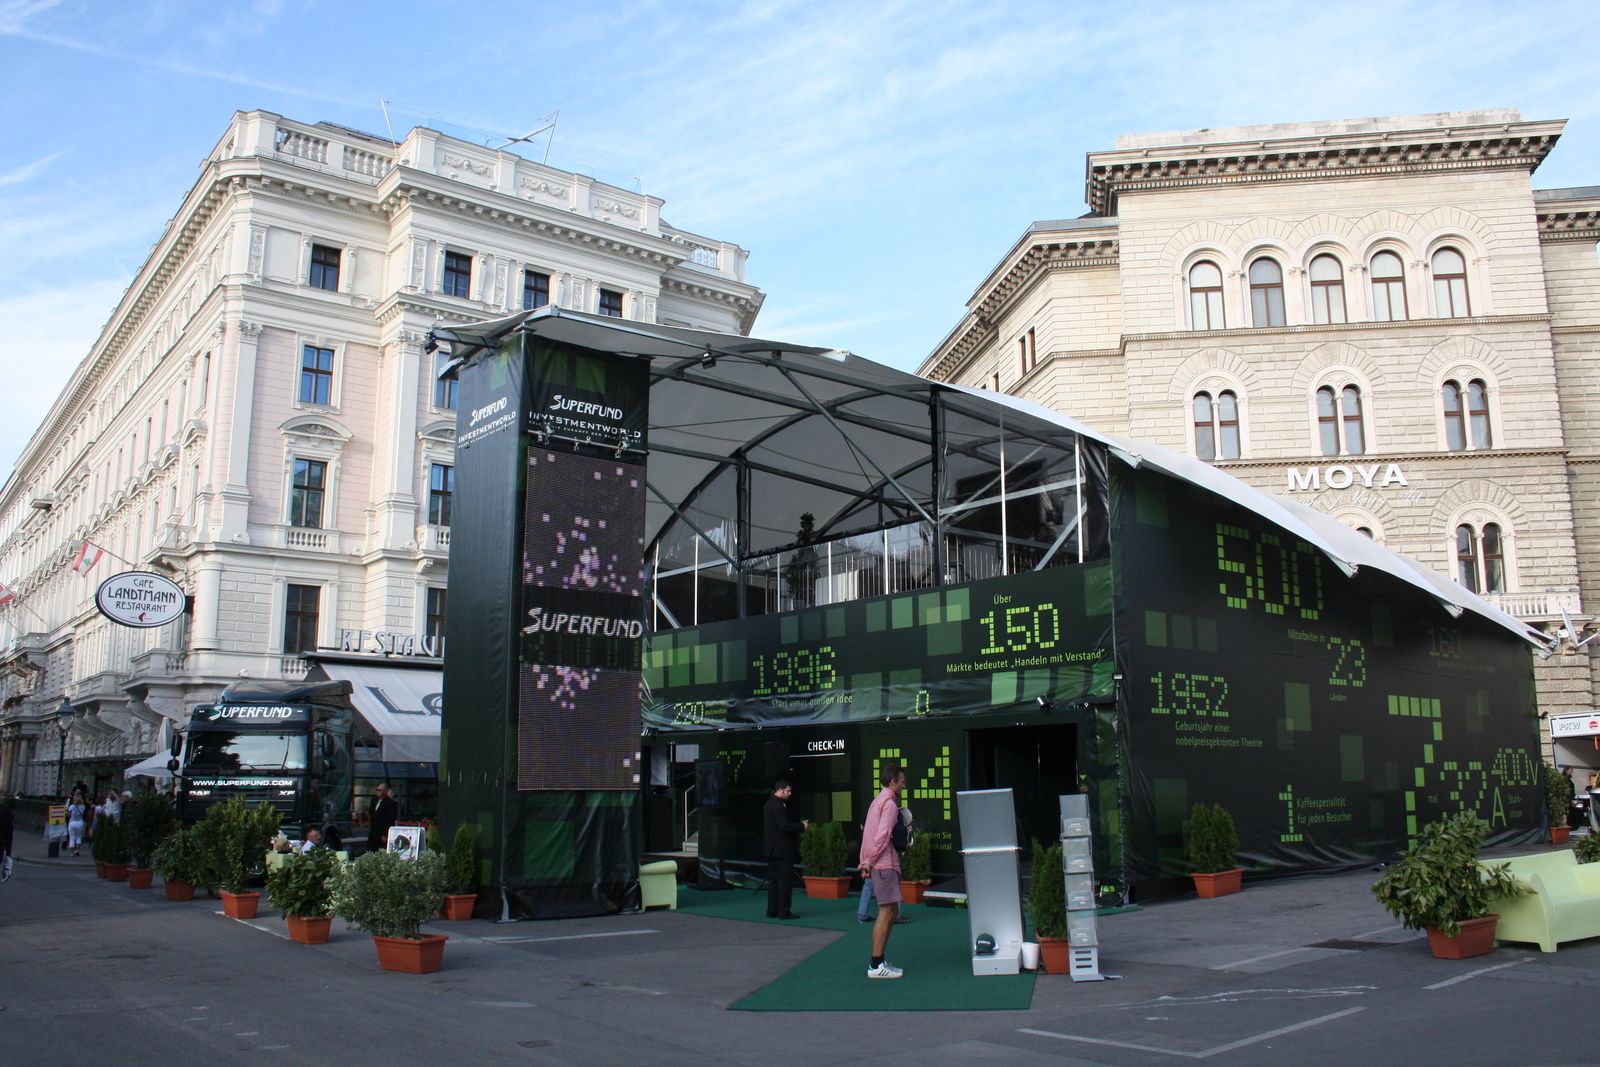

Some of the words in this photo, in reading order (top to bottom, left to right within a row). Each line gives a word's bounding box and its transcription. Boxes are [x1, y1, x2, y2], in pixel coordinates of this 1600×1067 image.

[470, 397, 507, 427] SUPERFUND
[550, 395, 623, 420] SUPERFUND
[458, 411, 516, 443] INVESTMENTWORLD
[529, 411, 641, 438] INVESTMENTWORLD
[1287, 463, 1409, 491] MOYA
[133, 578, 154, 589] CAFE
[1216, 523, 1324, 620] 500
[108, 586, 176, 604] LANDTMANN
[116, 600, 167, 613] RESTAURANT
[993, 593, 1012, 605] Über
[522, 607, 643, 639] SUPERFUND
[980, 602, 1060, 655] 150
[341, 629, 445, 658] RESTAU
[752, 646, 836, 695] 1996
[946, 662, 972, 673] Märkte
[974, 659, 1009, 671] bedeutet
[1050, 653, 1063, 663] mit
[1327, 637, 1366, 687] 23
[809, 695, 835, 709] großen
[836, 693, 853, 704] Idee
[1150, 671, 1229, 717] 1952
[209, 704, 292, 720] SUPERFUND
[1175, 721, 1213, 733] Geburtsjahr
[807, 739, 845, 752] CHECK-IN
[1387, 694, 1443, 852] 7
[1279, 784, 1304, 842] 1
